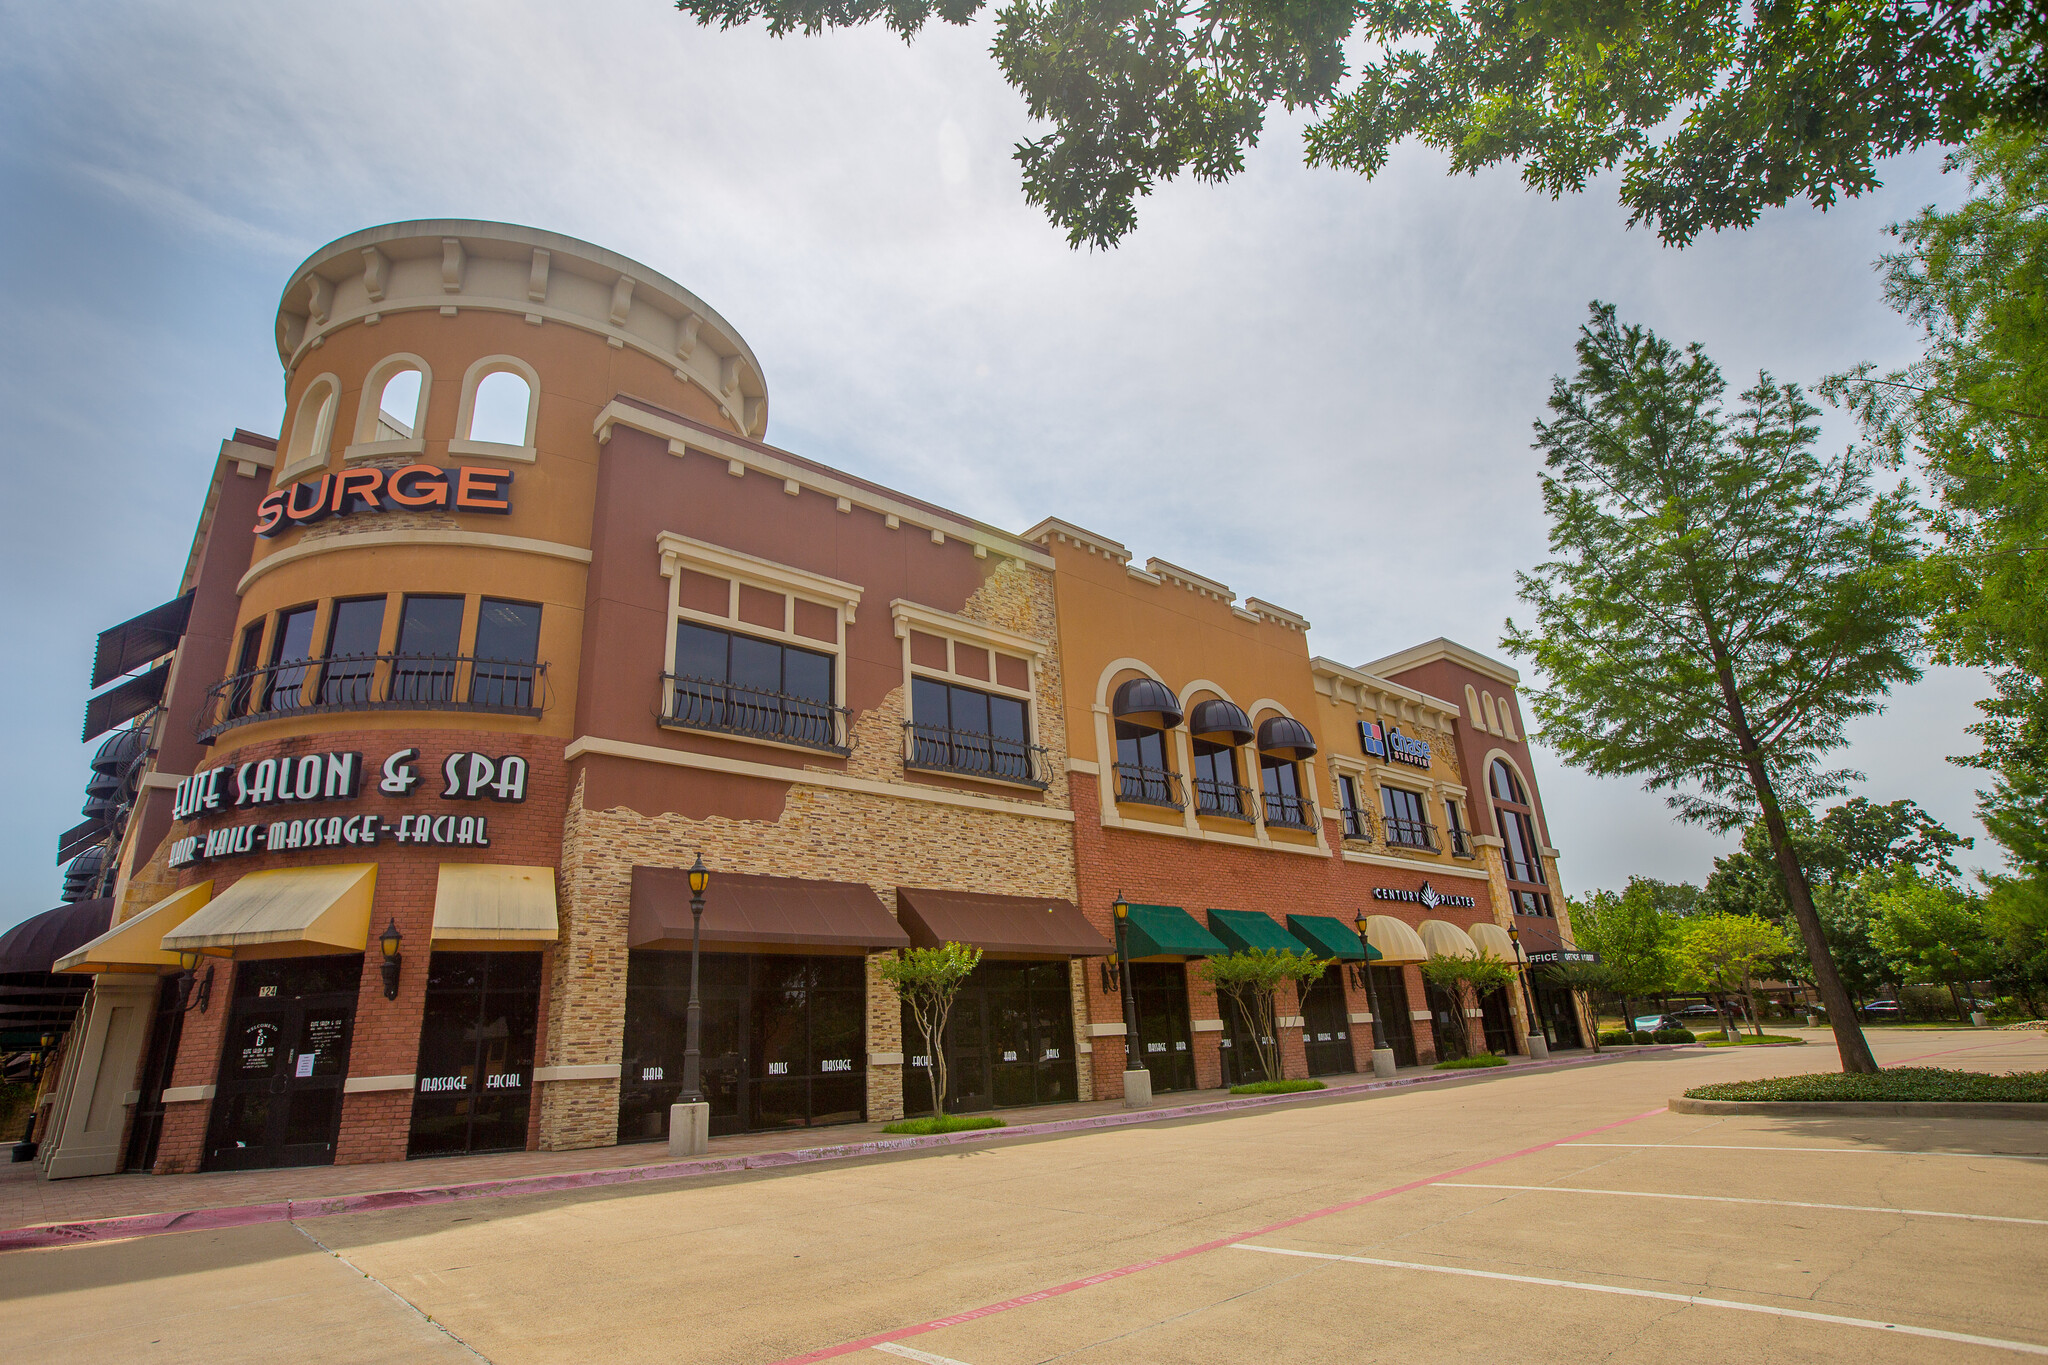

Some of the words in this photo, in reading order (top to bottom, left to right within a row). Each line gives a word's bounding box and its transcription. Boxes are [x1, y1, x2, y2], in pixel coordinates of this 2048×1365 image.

[251, 464, 510, 534] SURGE
[172, 766, 225, 821] ELITE
[235, 752, 353, 805] SALON
[380, 748, 416, 792] &
[444, 752, 526, 799] SPA
[1375, 887, 1420, 902] CENTURY
[1440, 894, 1476, 907] PILATES
[1527, 953, 1558, 963] FFICE
[260, 986, 277, 996] 124
[246, 1023, 272, 1034] WELCOME
[1004, 1051, 1017, 1061] HAIR
[642, 1067, 663, 1080] HAIR
[768, 1062, 788, 1074] NAILS
[822, 1059, 851, 1072] MASSAGE
[421, 1076, 467, 1092] MASSAGE
[486, 1073, 521, 1088] FACIAL
